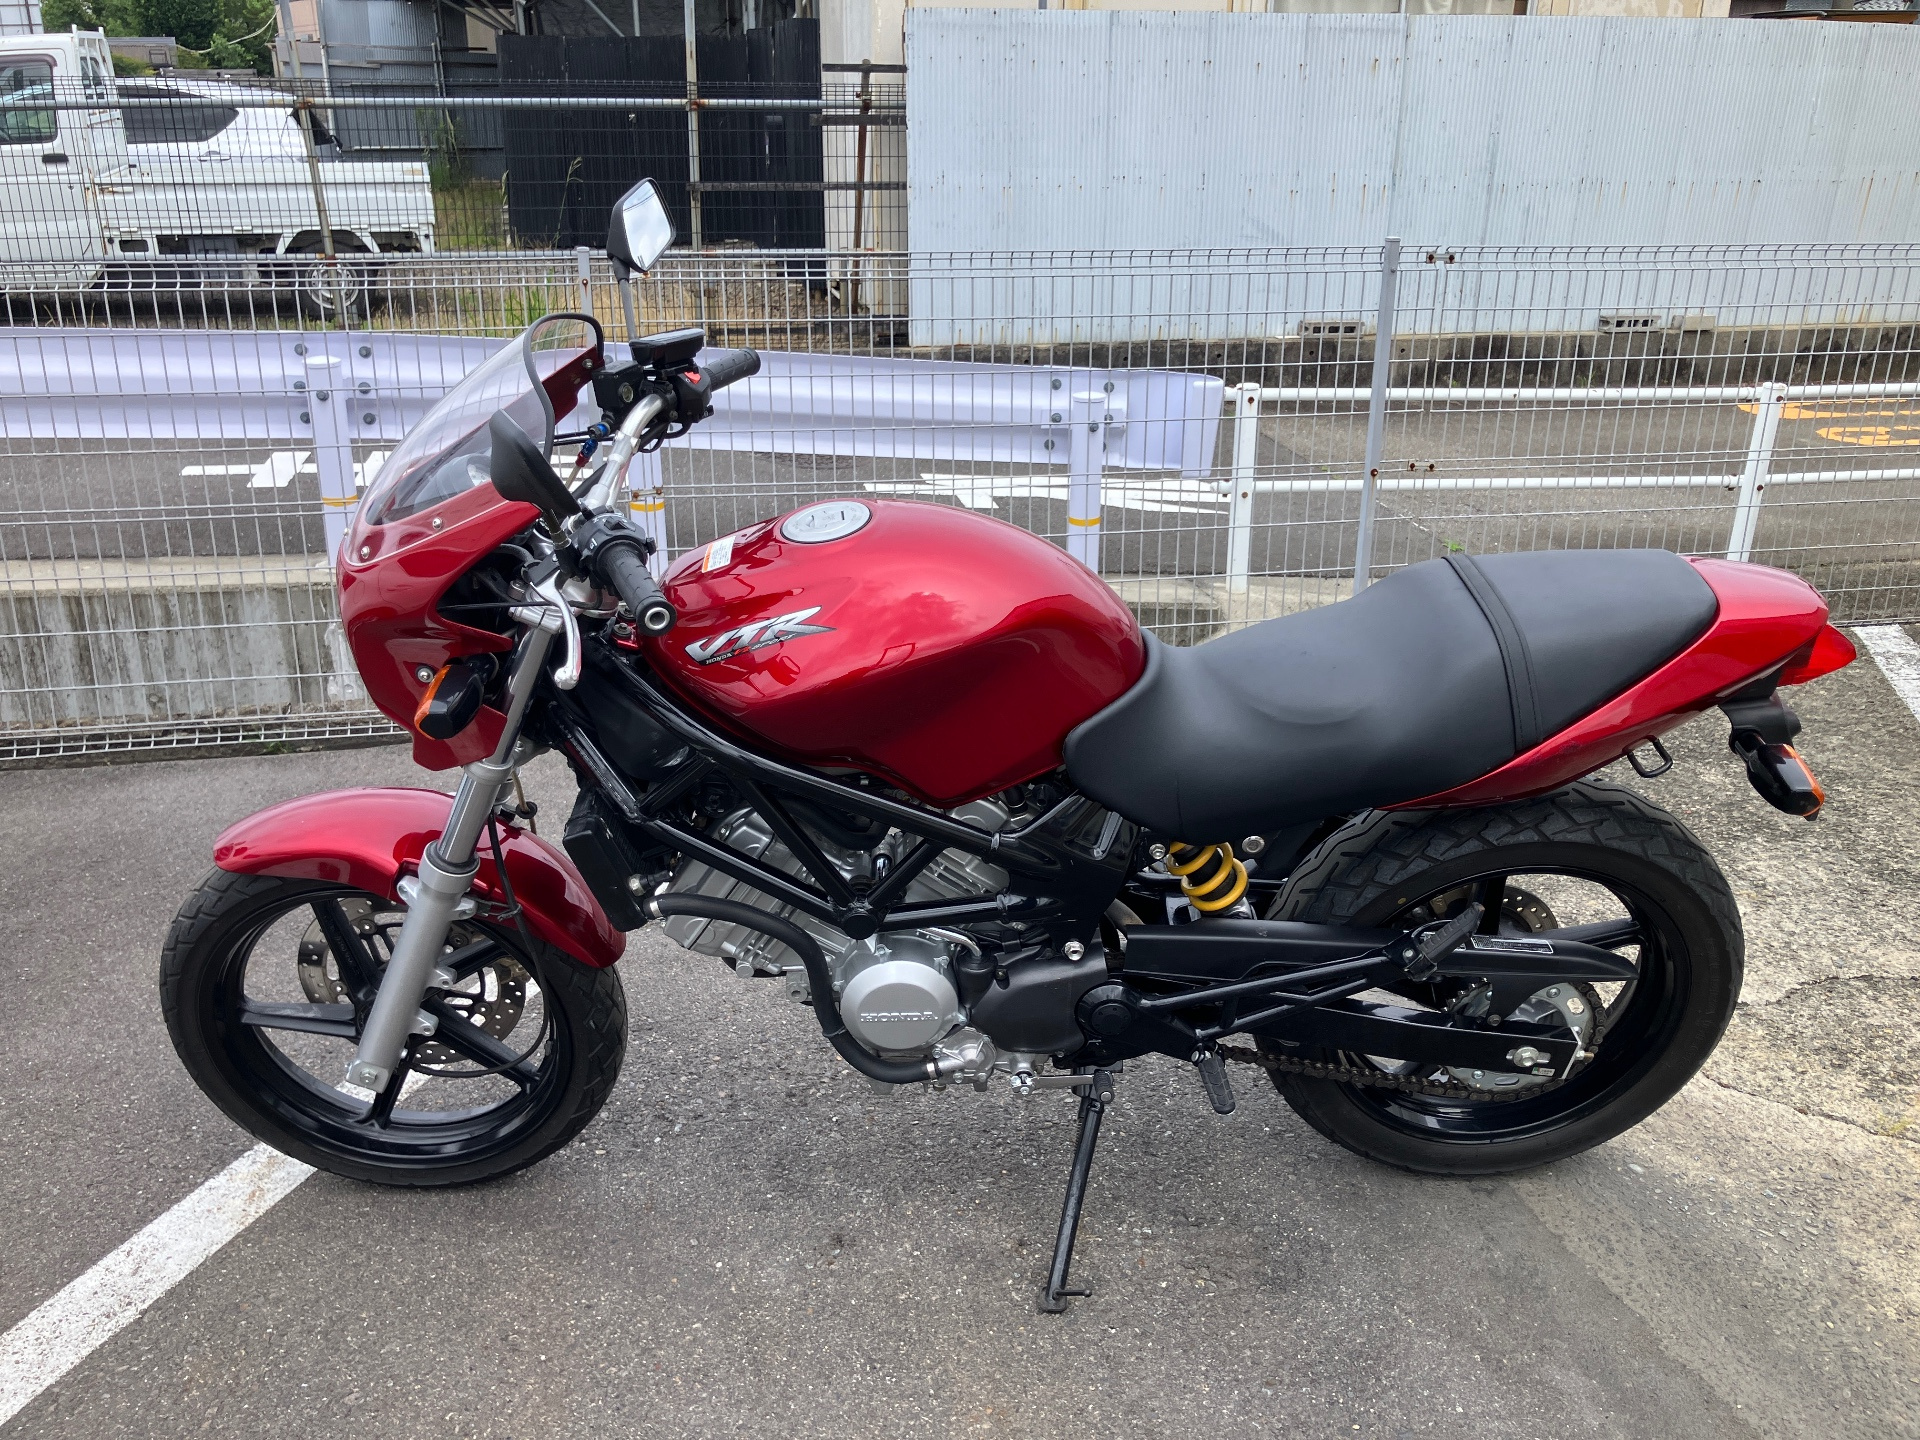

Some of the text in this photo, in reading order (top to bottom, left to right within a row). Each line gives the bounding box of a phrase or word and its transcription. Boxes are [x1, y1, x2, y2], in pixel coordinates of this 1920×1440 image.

[685, 606, 836, 663] VTR
[706, 652, 733, 665] HONDA
[860, 1011, 939, 1022] HONDA
